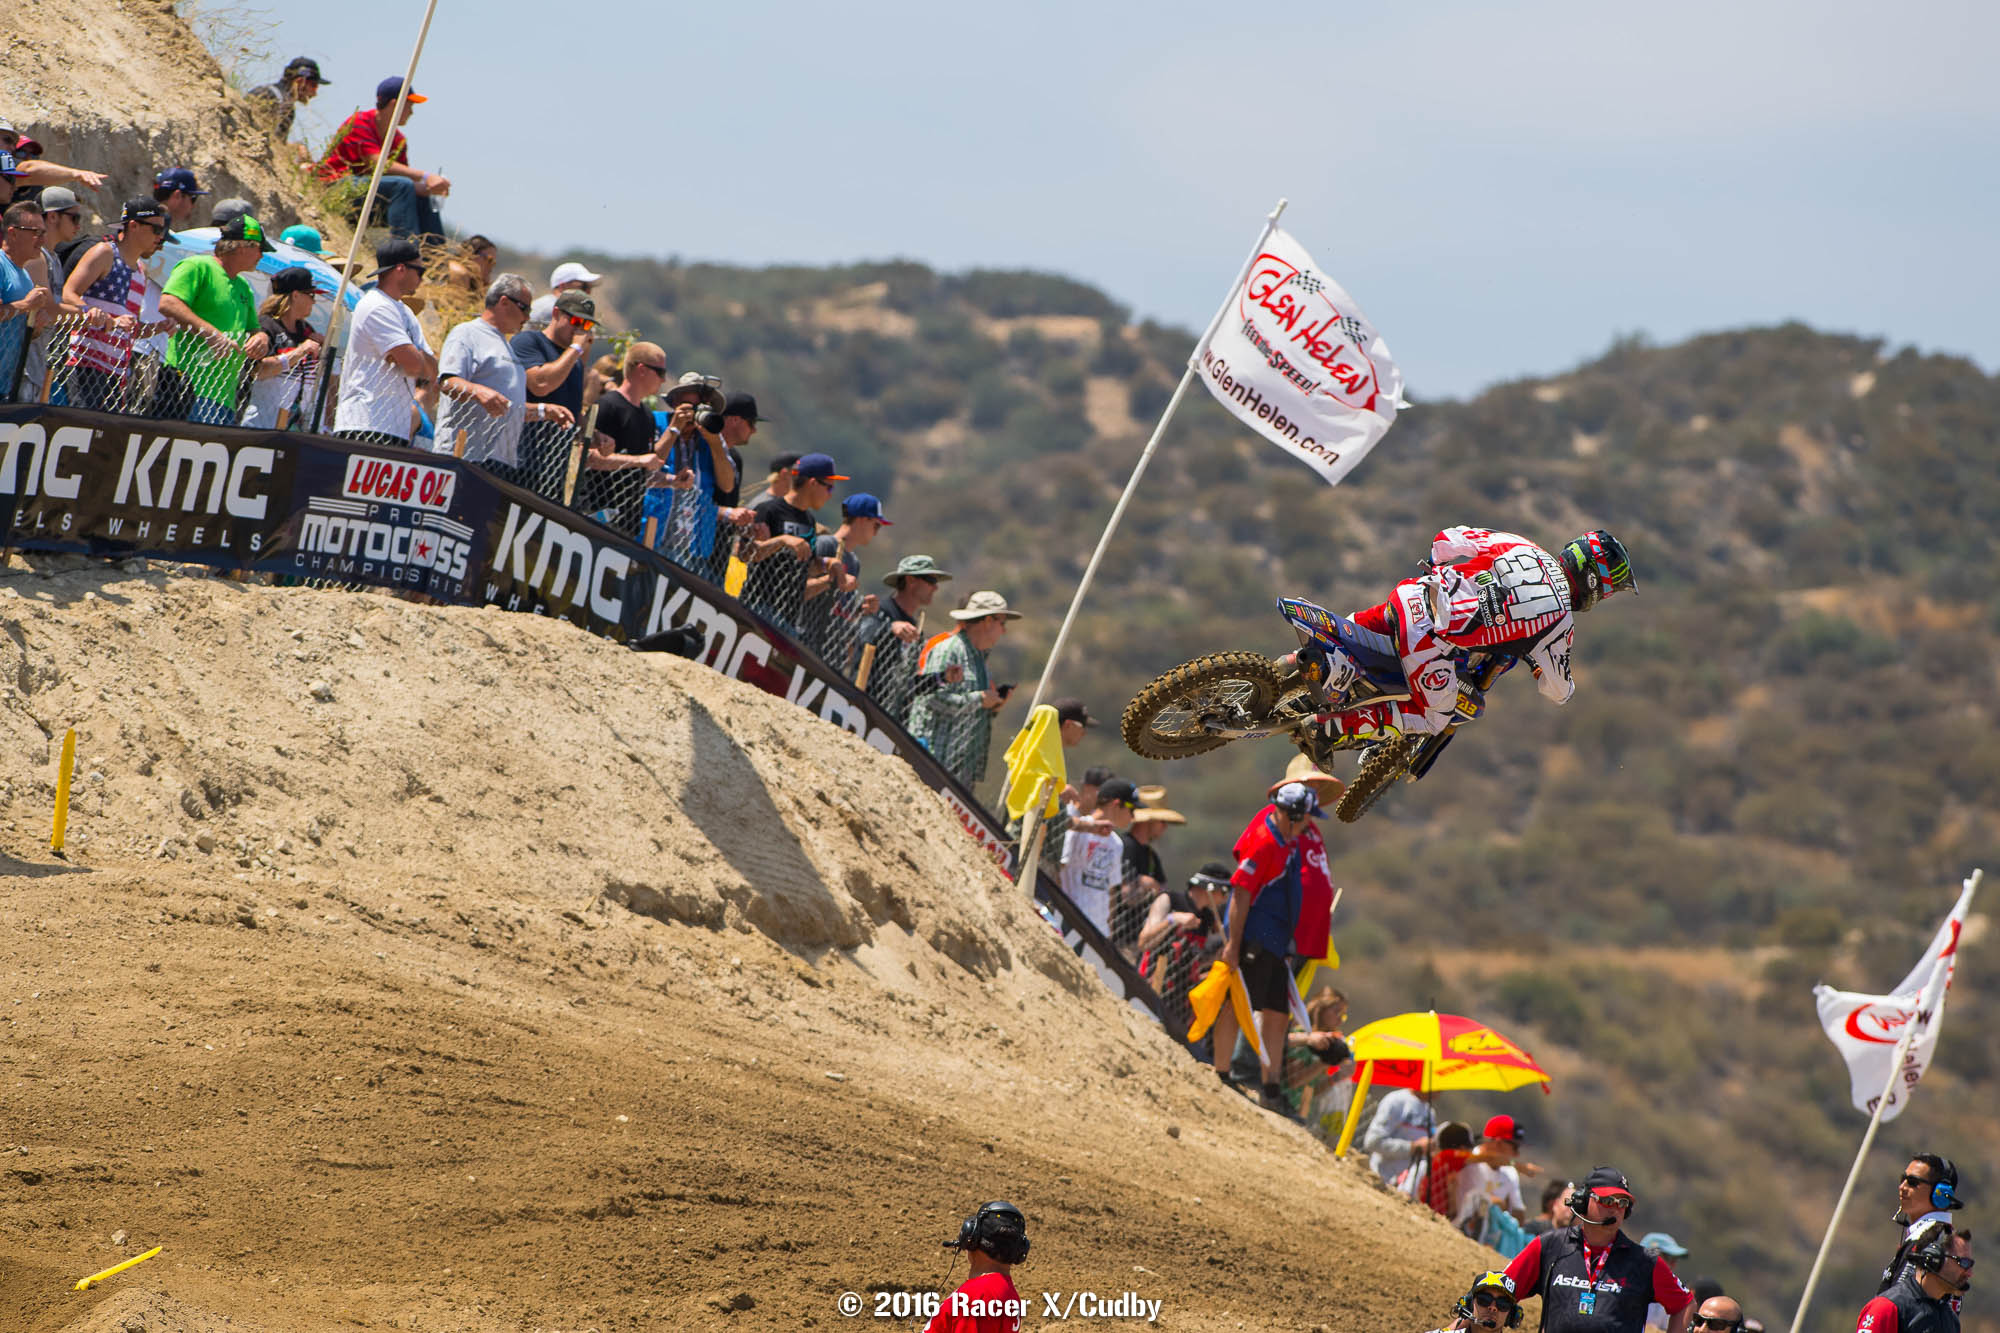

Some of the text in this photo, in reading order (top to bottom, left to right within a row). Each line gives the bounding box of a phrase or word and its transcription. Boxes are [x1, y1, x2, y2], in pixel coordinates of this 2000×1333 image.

[0, 422, 94, 499] MC
[113, 433, 275, 520] KMC
[347, 459, 452, 508] LUCAS OIL
[108, 517, 262, 551] WHEELS
[368, 504, 423, 526] PRO
[295, 552, 463, 597] CHAMPIOSHIP
[492, 502, 631, 625] KMC
[1494, 554, 1563, 622] 34
[1483, 602, 1494, 627] TOYOTA
[1457, 679, 1474, 696] MAHA
